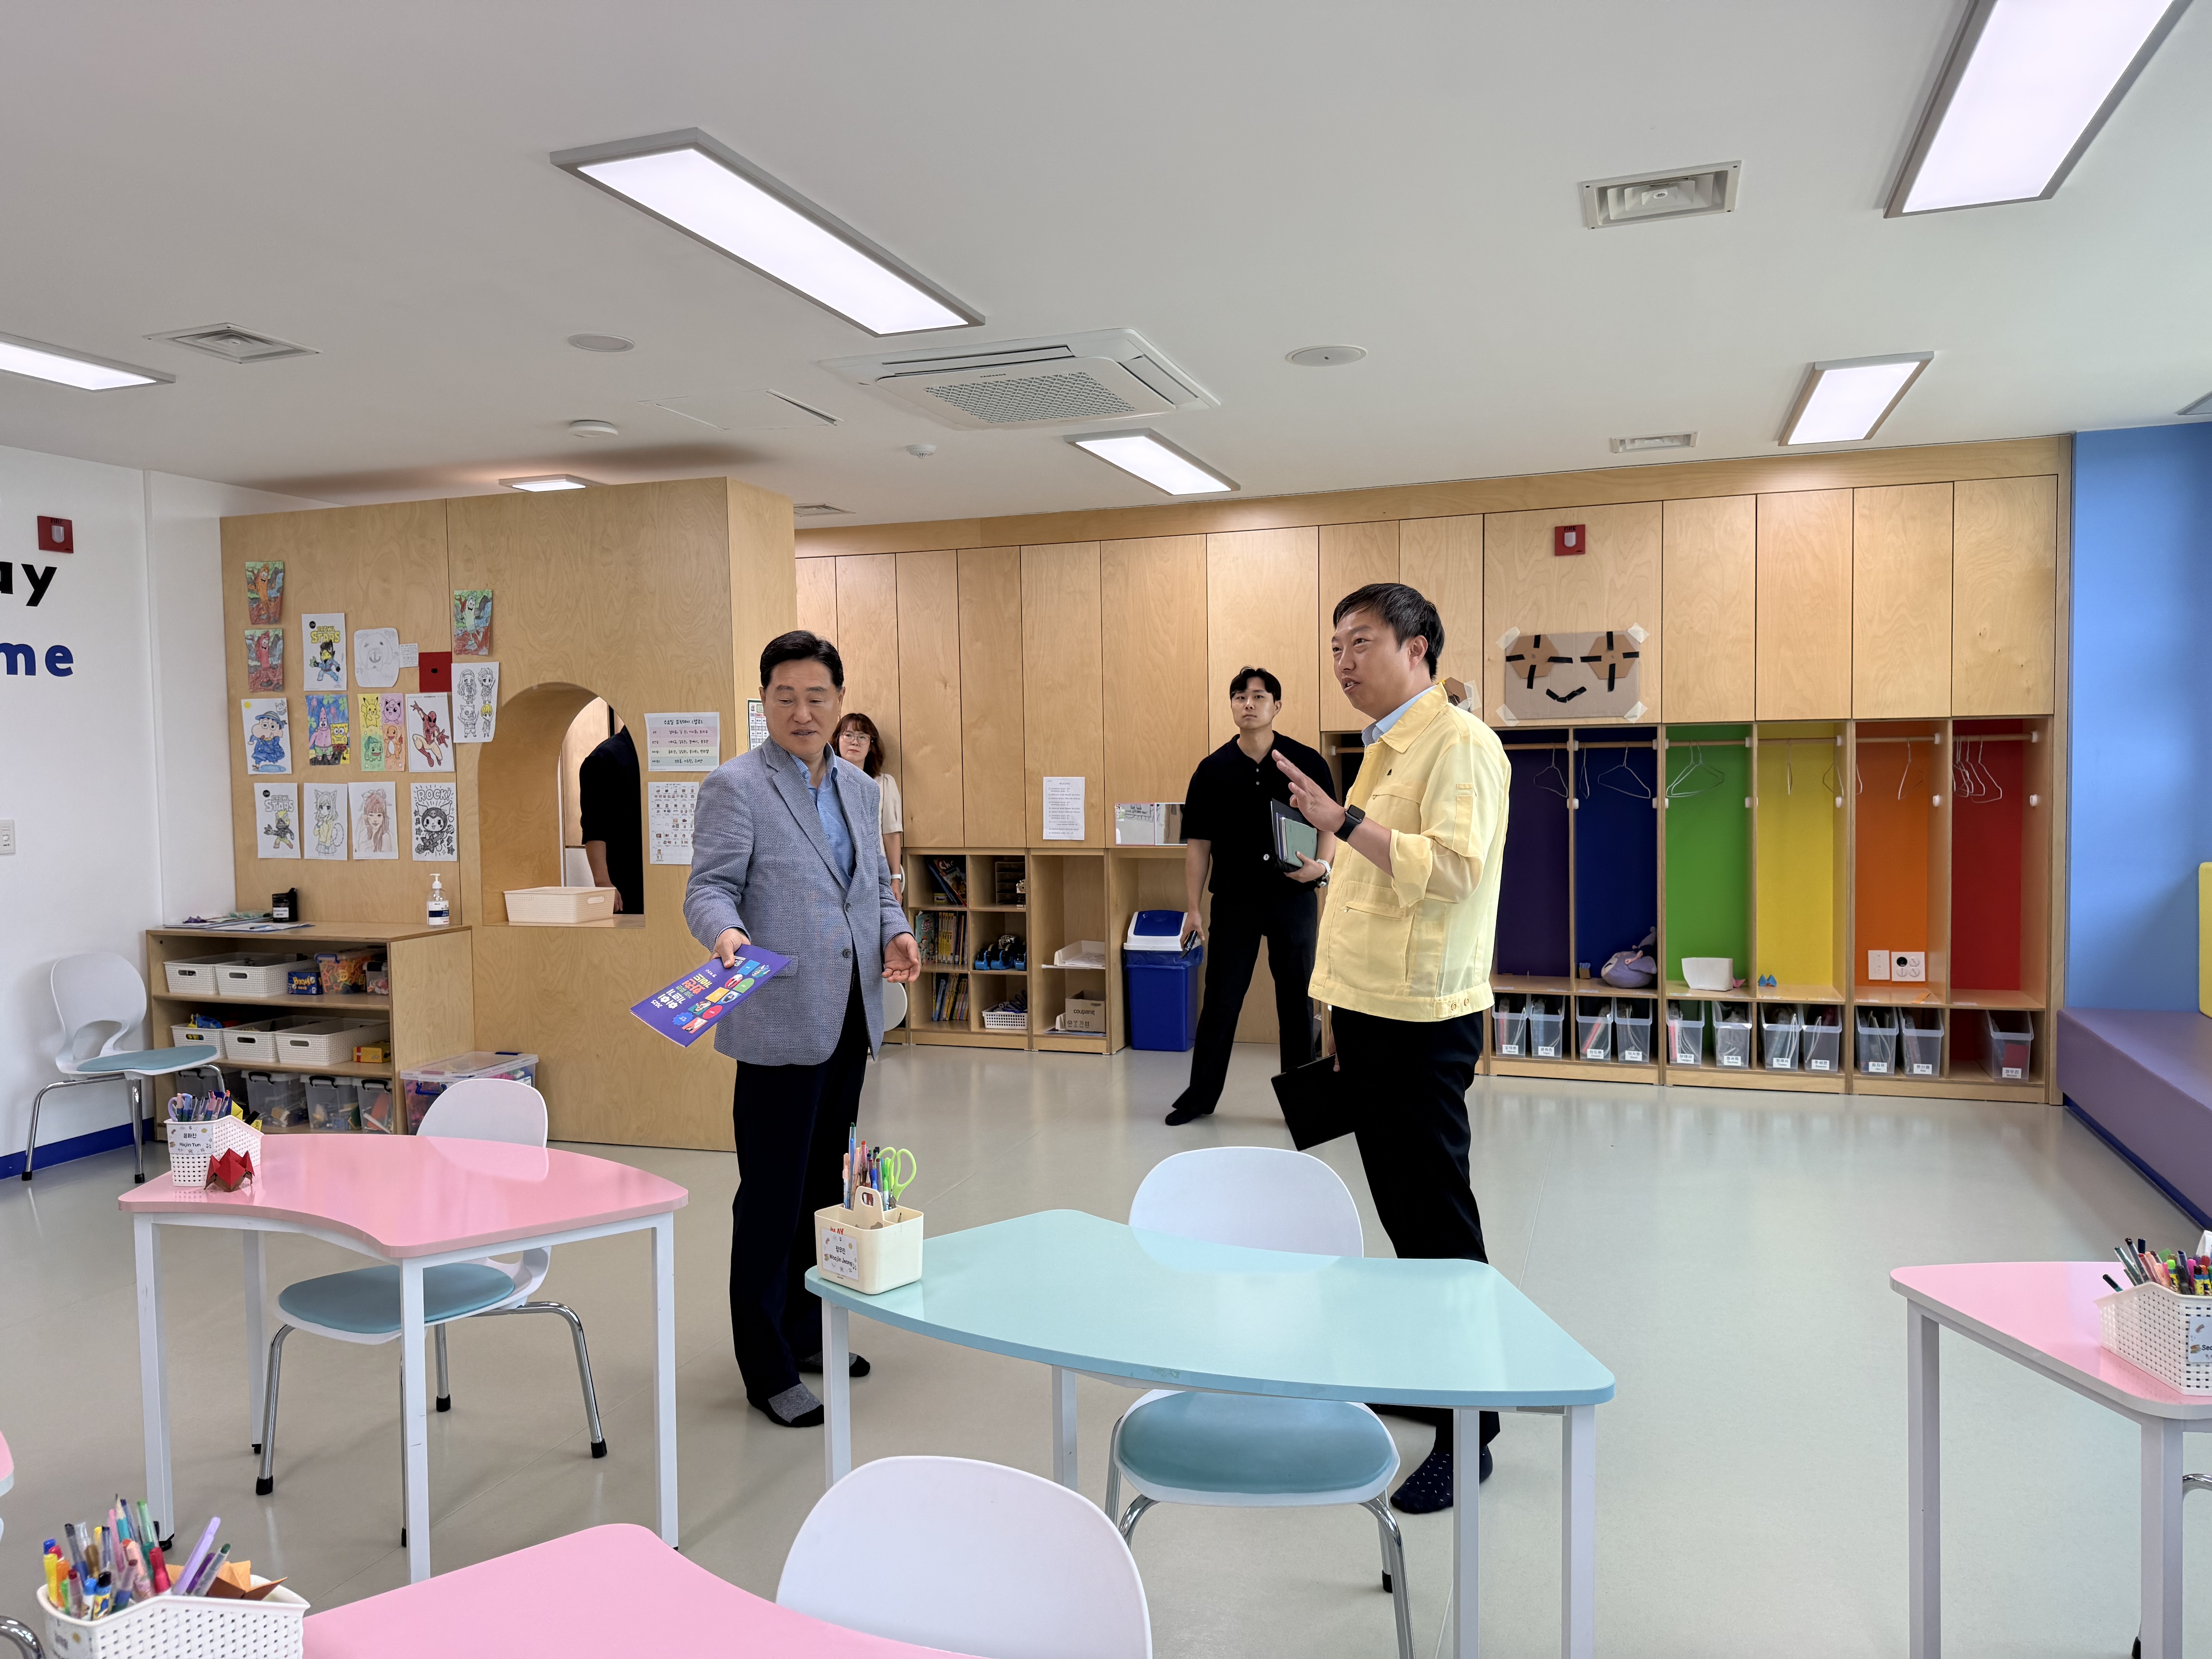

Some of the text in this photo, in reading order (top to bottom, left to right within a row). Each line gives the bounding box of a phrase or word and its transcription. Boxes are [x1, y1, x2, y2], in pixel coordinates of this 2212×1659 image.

[310, 630, 340, 644] STARS
[417, 789, 451, 802] ROCK!
[264, 799, 294, 812] STARS
[666, 989, 686, 1004] 기르기
[651, 1000, 663, 1008] 2025
[829, 1254, 852, 1267] Woojin Jeong
